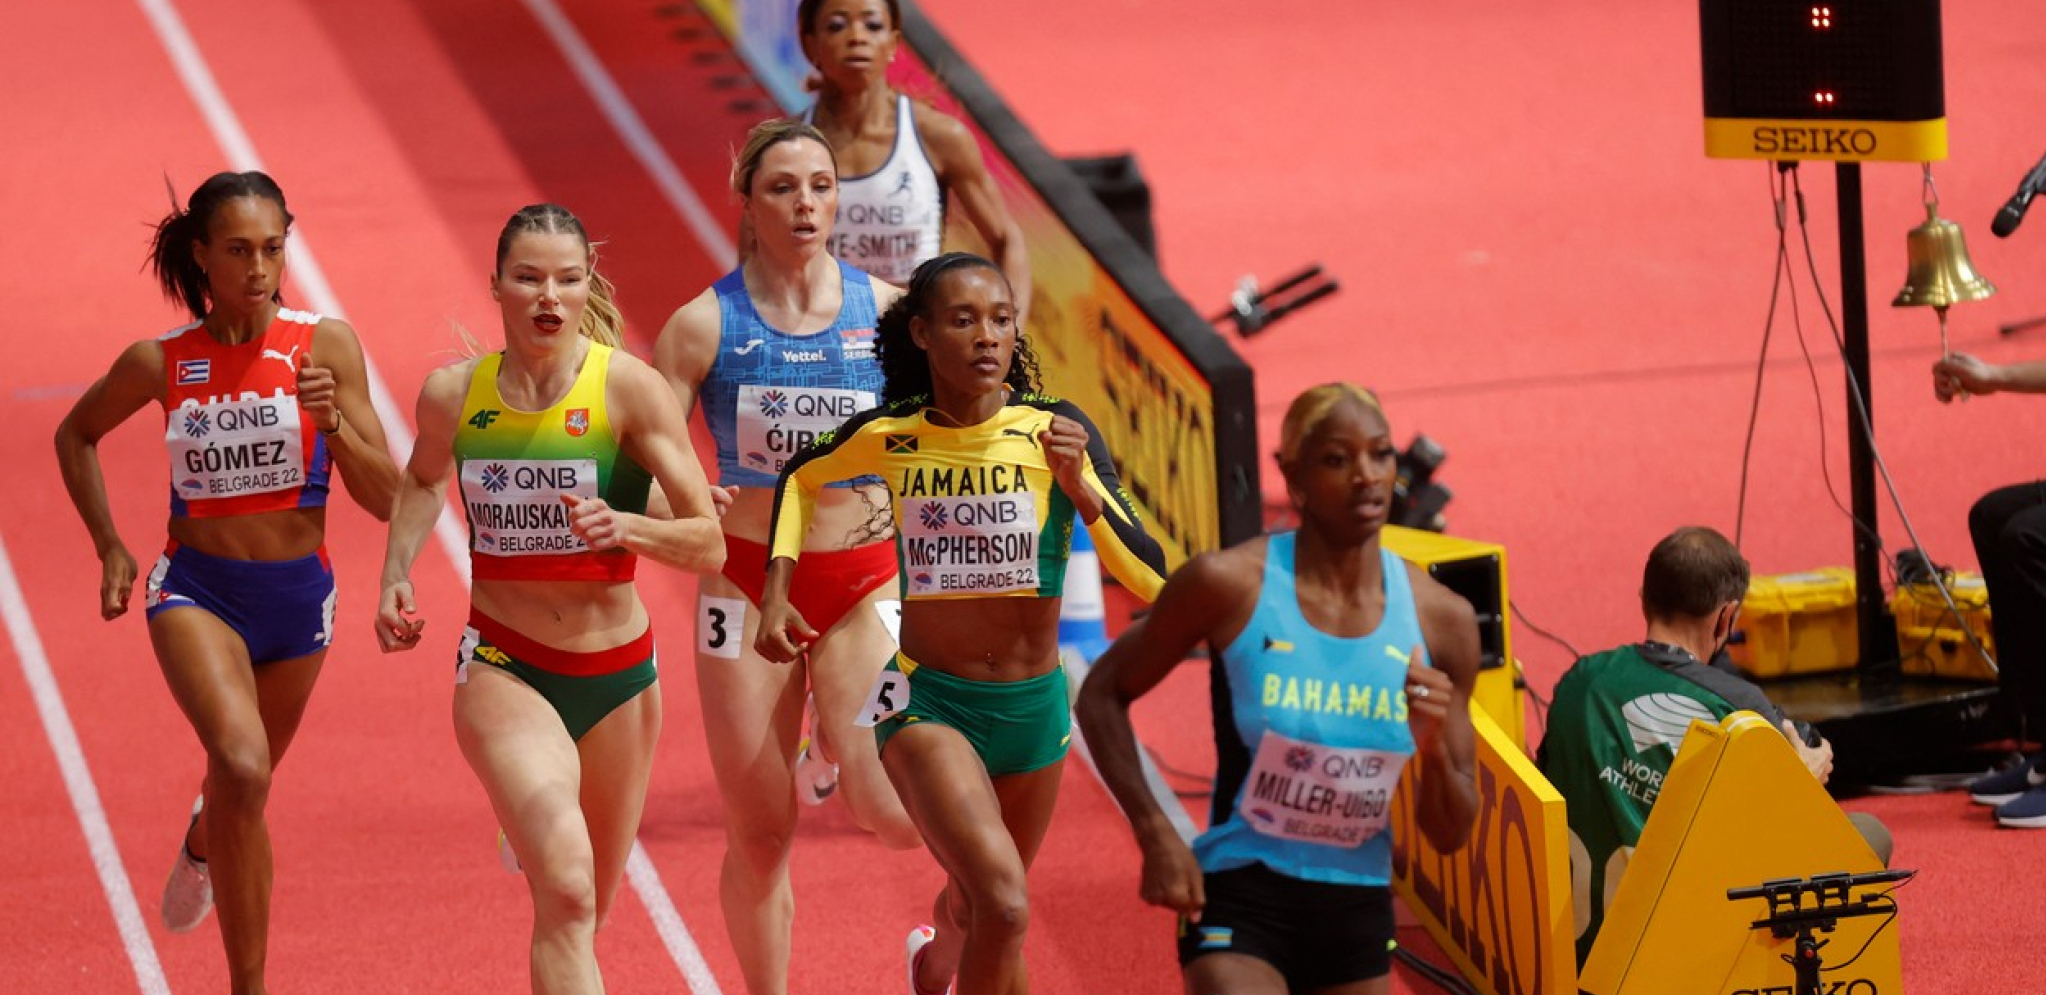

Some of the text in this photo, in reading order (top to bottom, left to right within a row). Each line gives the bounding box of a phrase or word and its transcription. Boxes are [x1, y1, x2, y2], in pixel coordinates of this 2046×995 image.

[1753, 127, 1877, 154] SEIKO
[847, 204, 904, 225] QNB
[217, 405, 279, 431] QNB
[468, 409, 500, 429] 4F
[795, 395, 856, 416] QNB
[184, 440, 287, 474] GÓMEZ
[209, 467, 299, 494] BELGRADE 22
[515, 467, 577, 490] QNB
[899, 465, 1028, 497] JAMAICA
[954, 501, 1018, 526] QNB
[501, 536, 572, 551] BELGRADE
[908, 532, 1032, 566] McPHERSON
[940, 568, 1034, 589] BELGRADE 22
[707, 607, 726, 648] 3
[873, 681, 896, 722] 5
[1262, 673, 1409, 722] BAHAMAS
[1322, 755, 1384, 779] QNB
[1622, 758, 1663, 789] WOR
[1253, 772, 1387, 819] MILLER-UIBO
[1599, 766, 1654, 805] ATHLE
